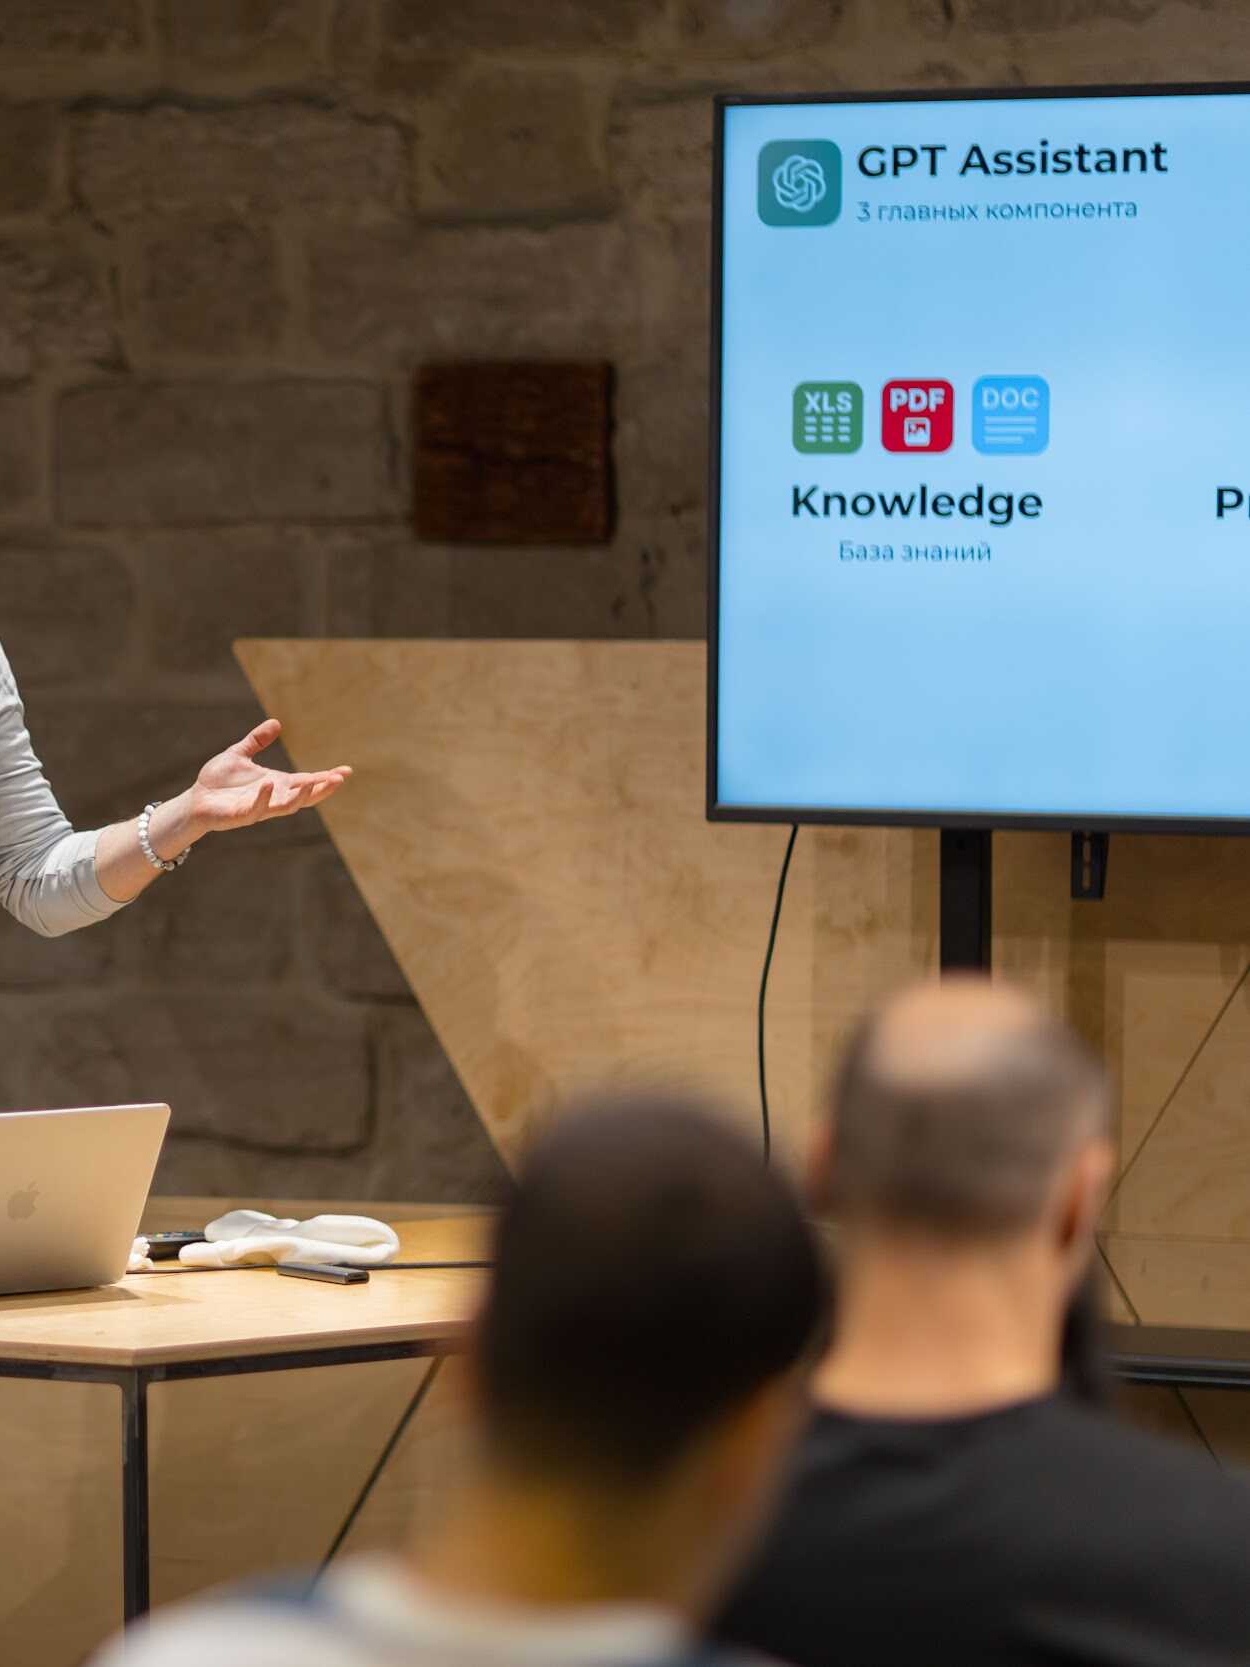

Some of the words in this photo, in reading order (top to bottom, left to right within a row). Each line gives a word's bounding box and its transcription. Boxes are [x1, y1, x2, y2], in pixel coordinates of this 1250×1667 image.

[857, 144, 947, 179] GPT
[958, 139, 1169, 177] Assistant
[856, 201, 871, 222] 3
[877, 202, 979, 222] главных
[985, 200, 1138, 222] компонента
[803, 391, 853, 413] XLS
[889, 387, 946, 412] PDF
[981, 386, 1040, 410] DOC
[792, 483, 1043, 526] Knowledge
[1216, 486, 1250, 518] P
[838, 540, 894, 562] База
[900, 541, 992, 562] знаний
